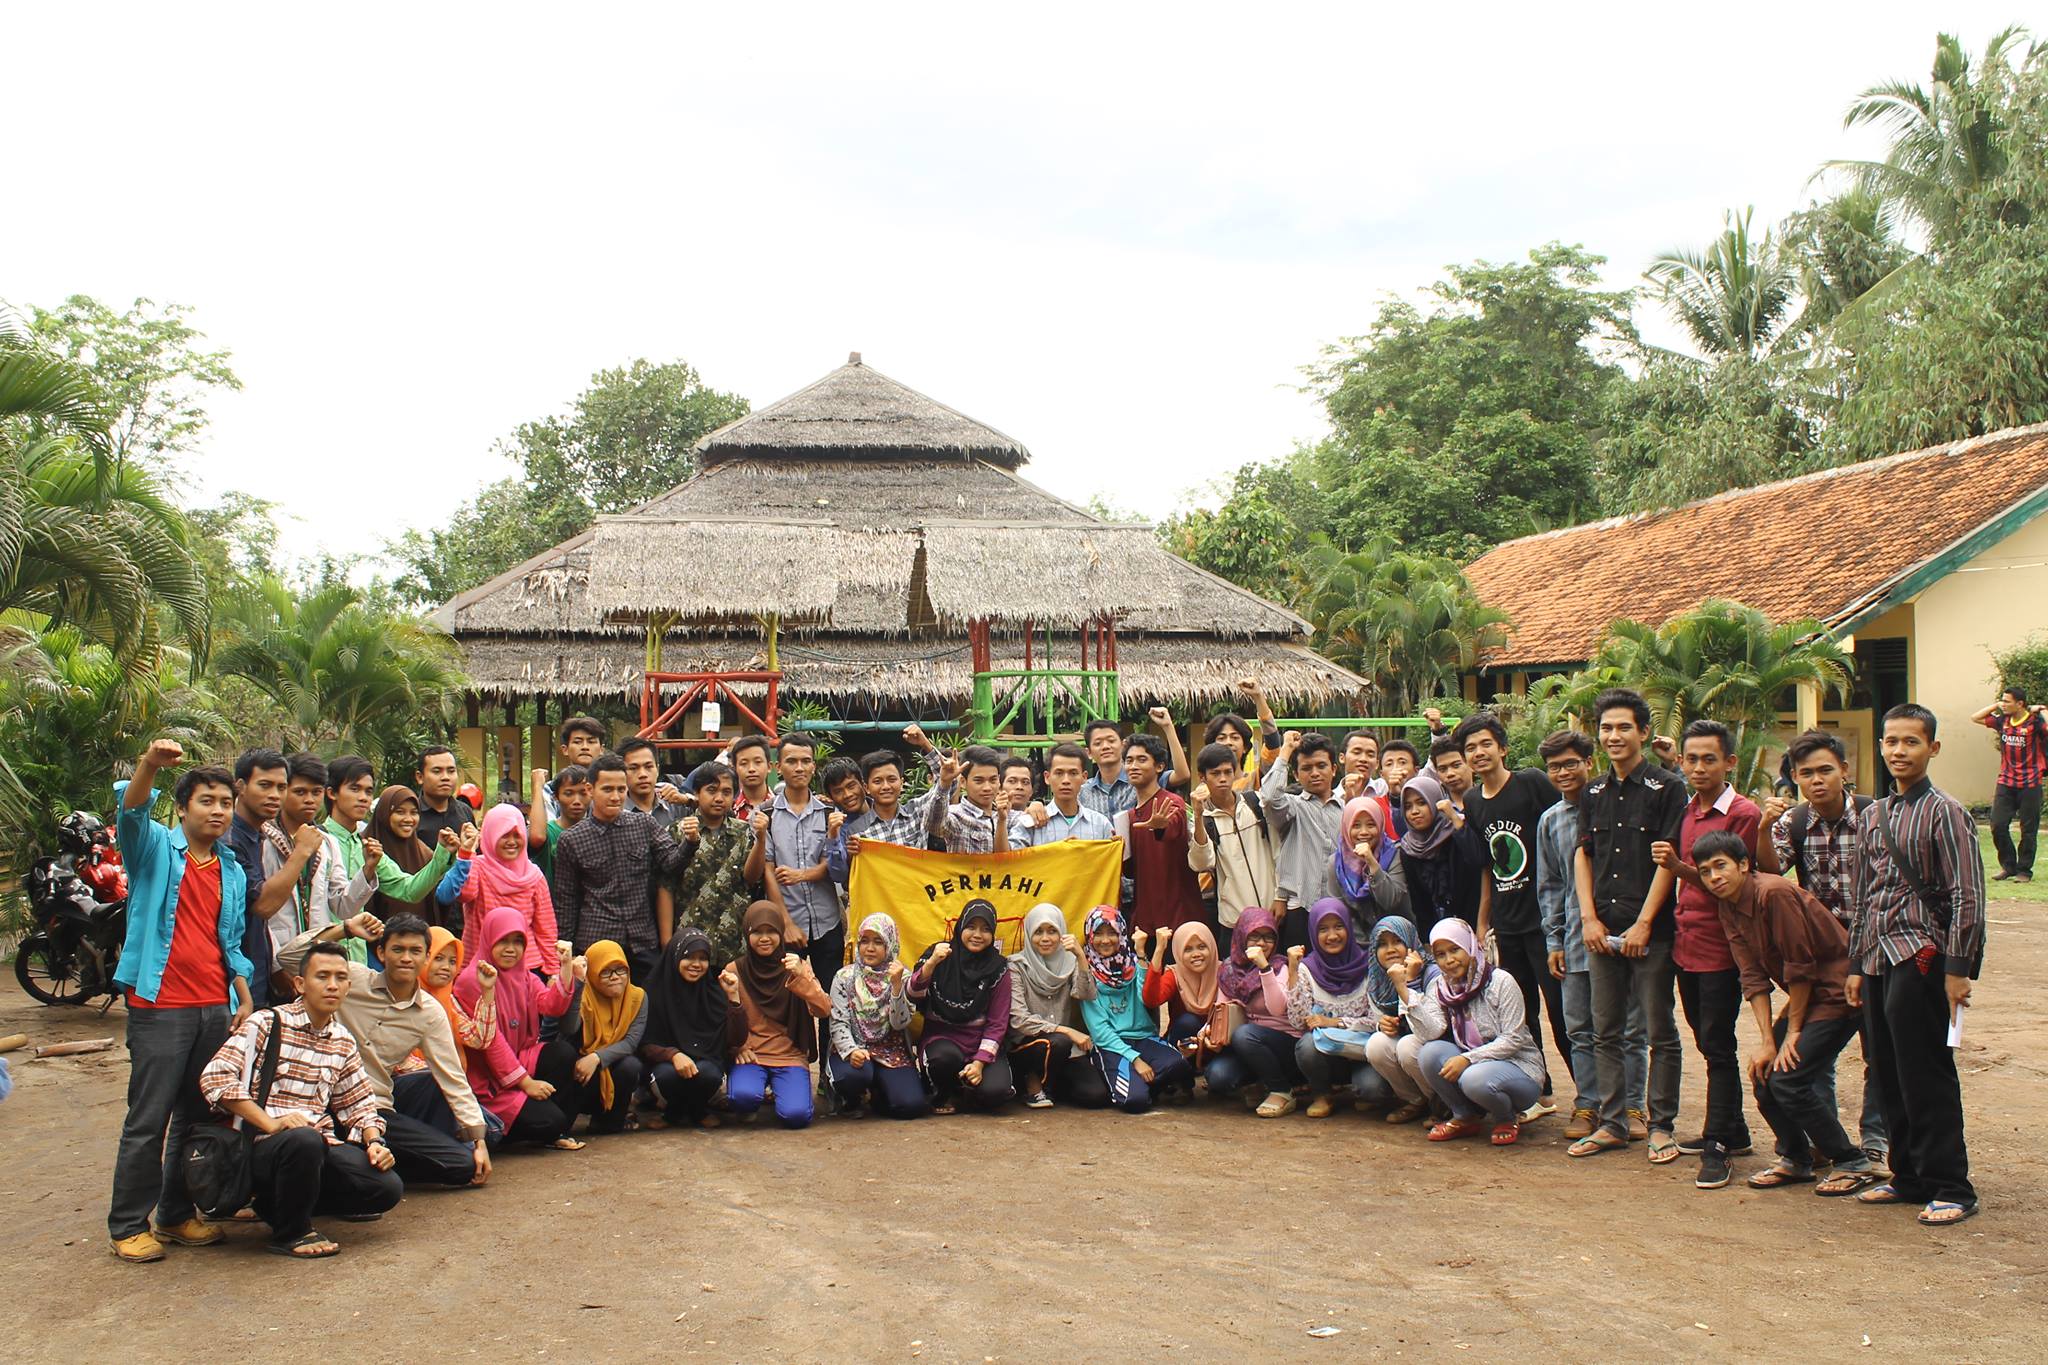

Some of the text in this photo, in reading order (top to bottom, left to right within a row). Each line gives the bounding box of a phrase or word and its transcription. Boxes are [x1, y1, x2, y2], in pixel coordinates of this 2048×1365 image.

[2001, 733, 2026, 744] QATAR
[1497, 820, 1522, 836] DUR
[924, 873, 1043, 902] PERMAHI
